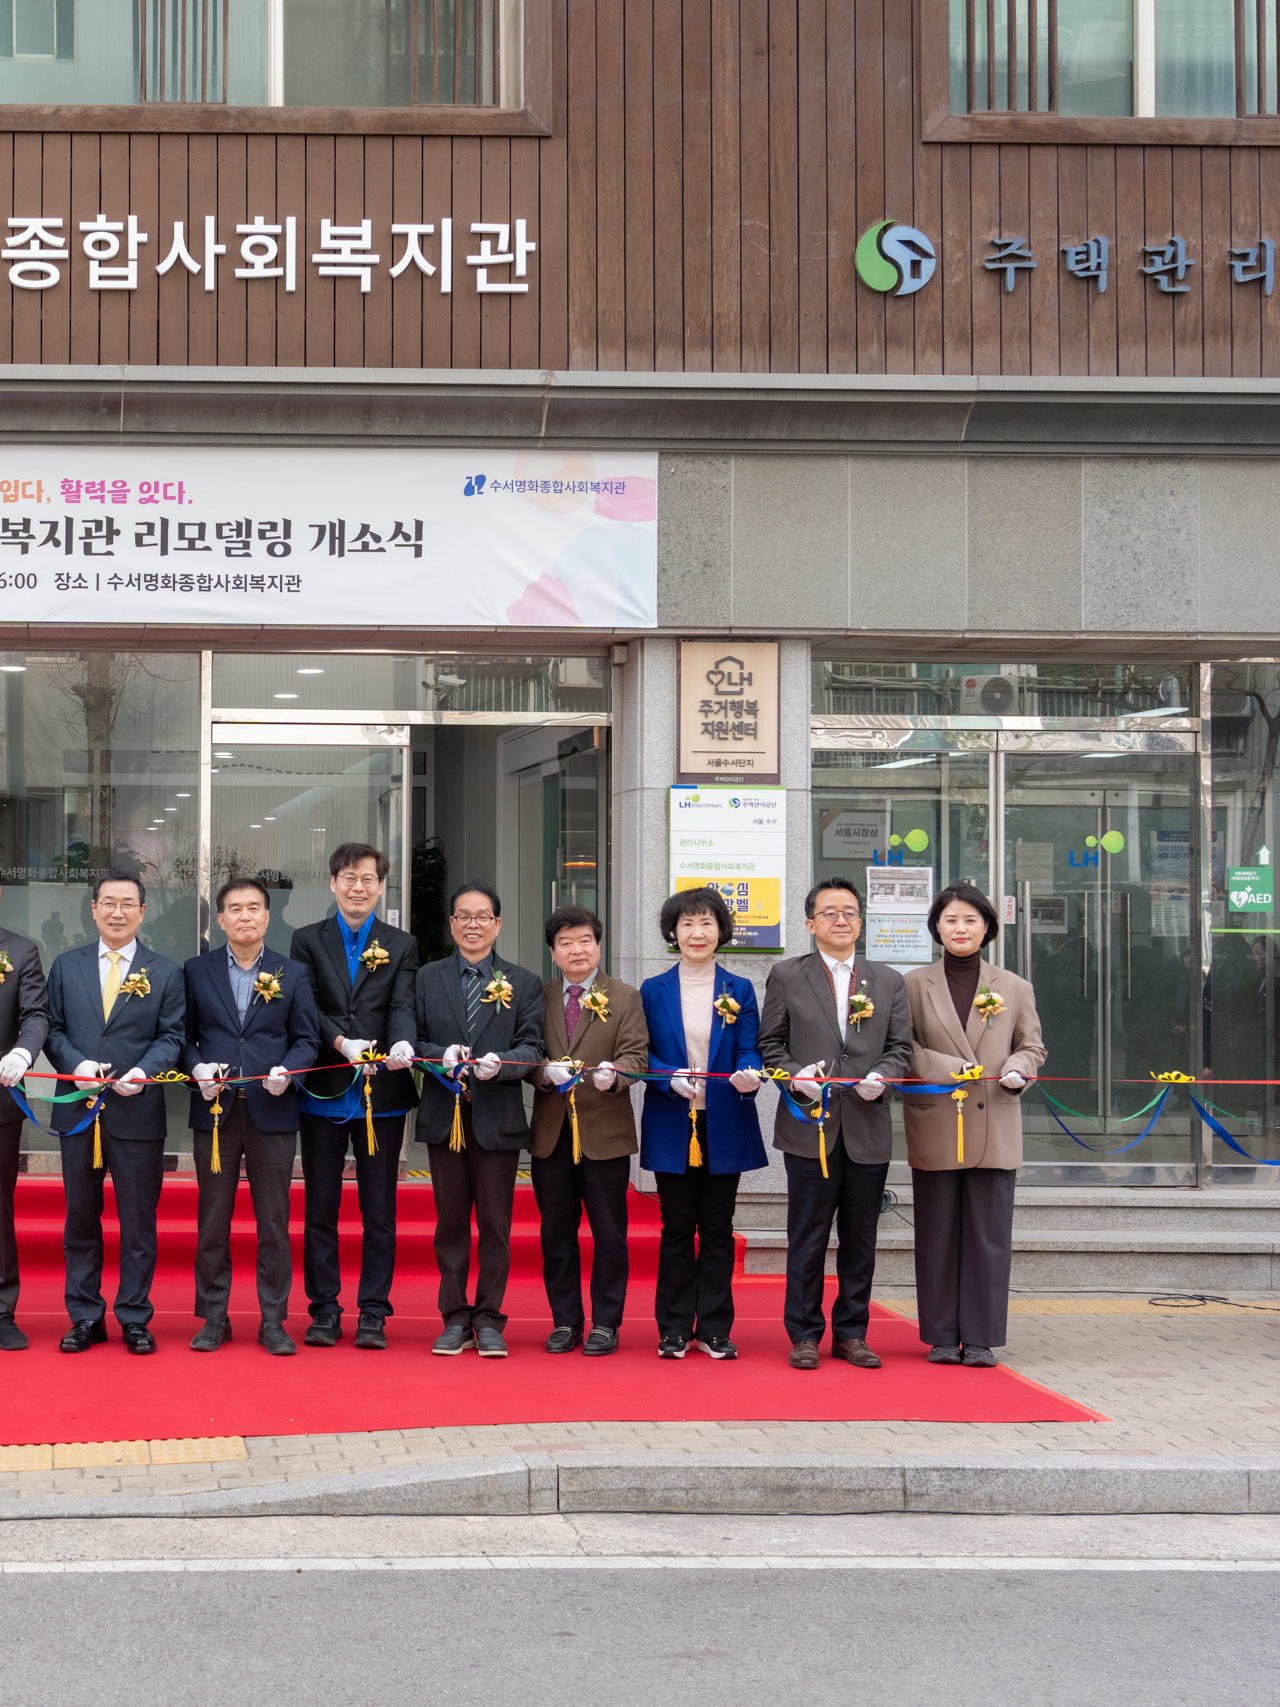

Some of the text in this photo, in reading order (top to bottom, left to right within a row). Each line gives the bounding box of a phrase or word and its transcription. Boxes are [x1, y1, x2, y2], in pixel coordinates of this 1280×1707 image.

[0, 478, 52, 506] 입다,
[60, 477, 131, 505] 활력을
[138, 479, 193, 505] 잇다.
[490, 478, 626, 497] 수서명화종합사회복지관
[133, 516, 293, 559] 리모델링
[309, 517, 424, 560] 개소식
[54, 573, 88, 591] 장소
[106, 573, 303, 594] 수서명화종합사회복지관
[727, 672, 753, 687] LH
[699, 699, 759, 719] 주거행복
[700, 720, 758, 741] 지원센터
[706, 758, 754, 768] 서울수서단지
[678, 801, 691, 809] LH
[742, 801, 777, 809] 주택관리공단
[834, 827, 879, 838] 서울시장상
[679, 838, 715, 847] 관리사무소
[173, 857, 197, 869] 수서
[873, 849, 903, 866] LH
[1069, 850, 1099, 867] LH
[679, 861, 756, 871] 수서명화종합사회복지관
[1247, 893, 1272, 904] AED
